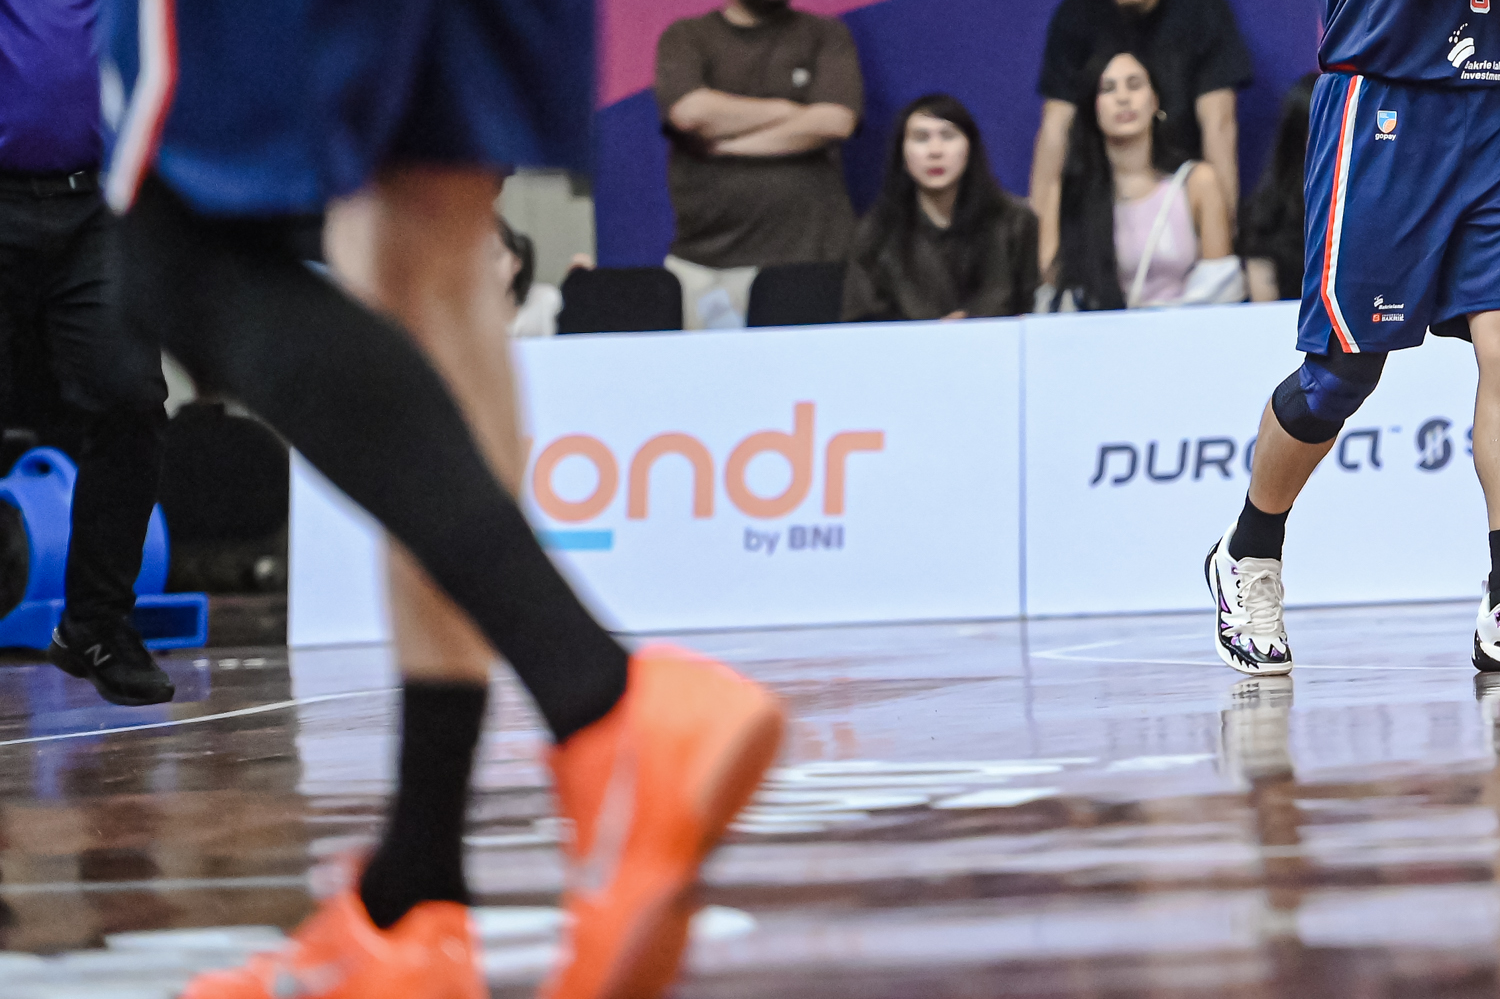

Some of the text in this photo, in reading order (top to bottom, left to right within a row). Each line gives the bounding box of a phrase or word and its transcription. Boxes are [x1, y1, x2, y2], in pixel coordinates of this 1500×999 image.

[1375, 133, 1397, 141] gopay
[526, 401, 885, 524] ondr
[743, 524, 845, 557] by BNI
